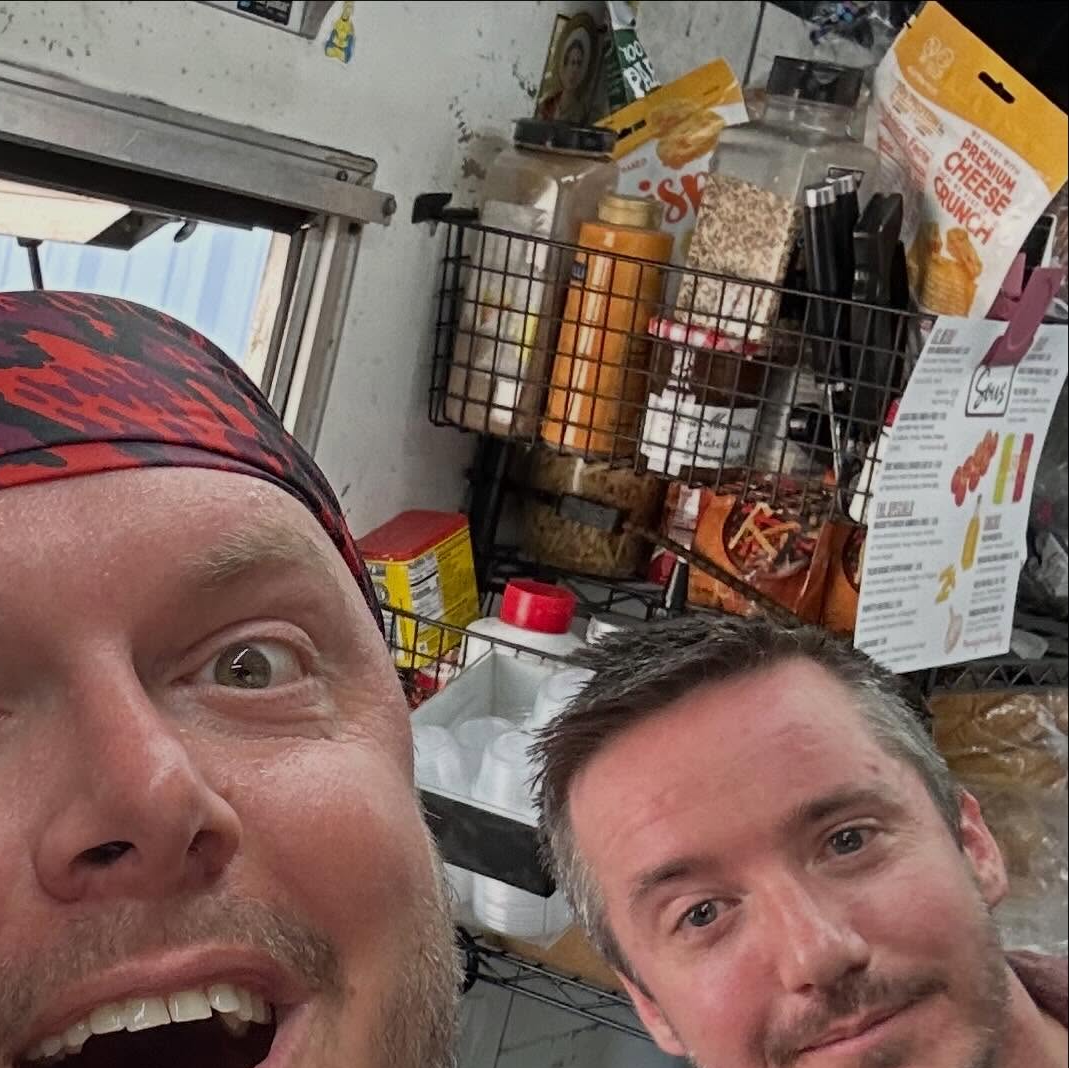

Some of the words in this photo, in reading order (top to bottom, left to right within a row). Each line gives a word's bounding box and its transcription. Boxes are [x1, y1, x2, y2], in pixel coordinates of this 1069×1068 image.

[944, 151, 1011, 217] CHEESE
[960, 137, 1017, 195] PREMIUM
[934, 175, 995, 246] CRUNCH
